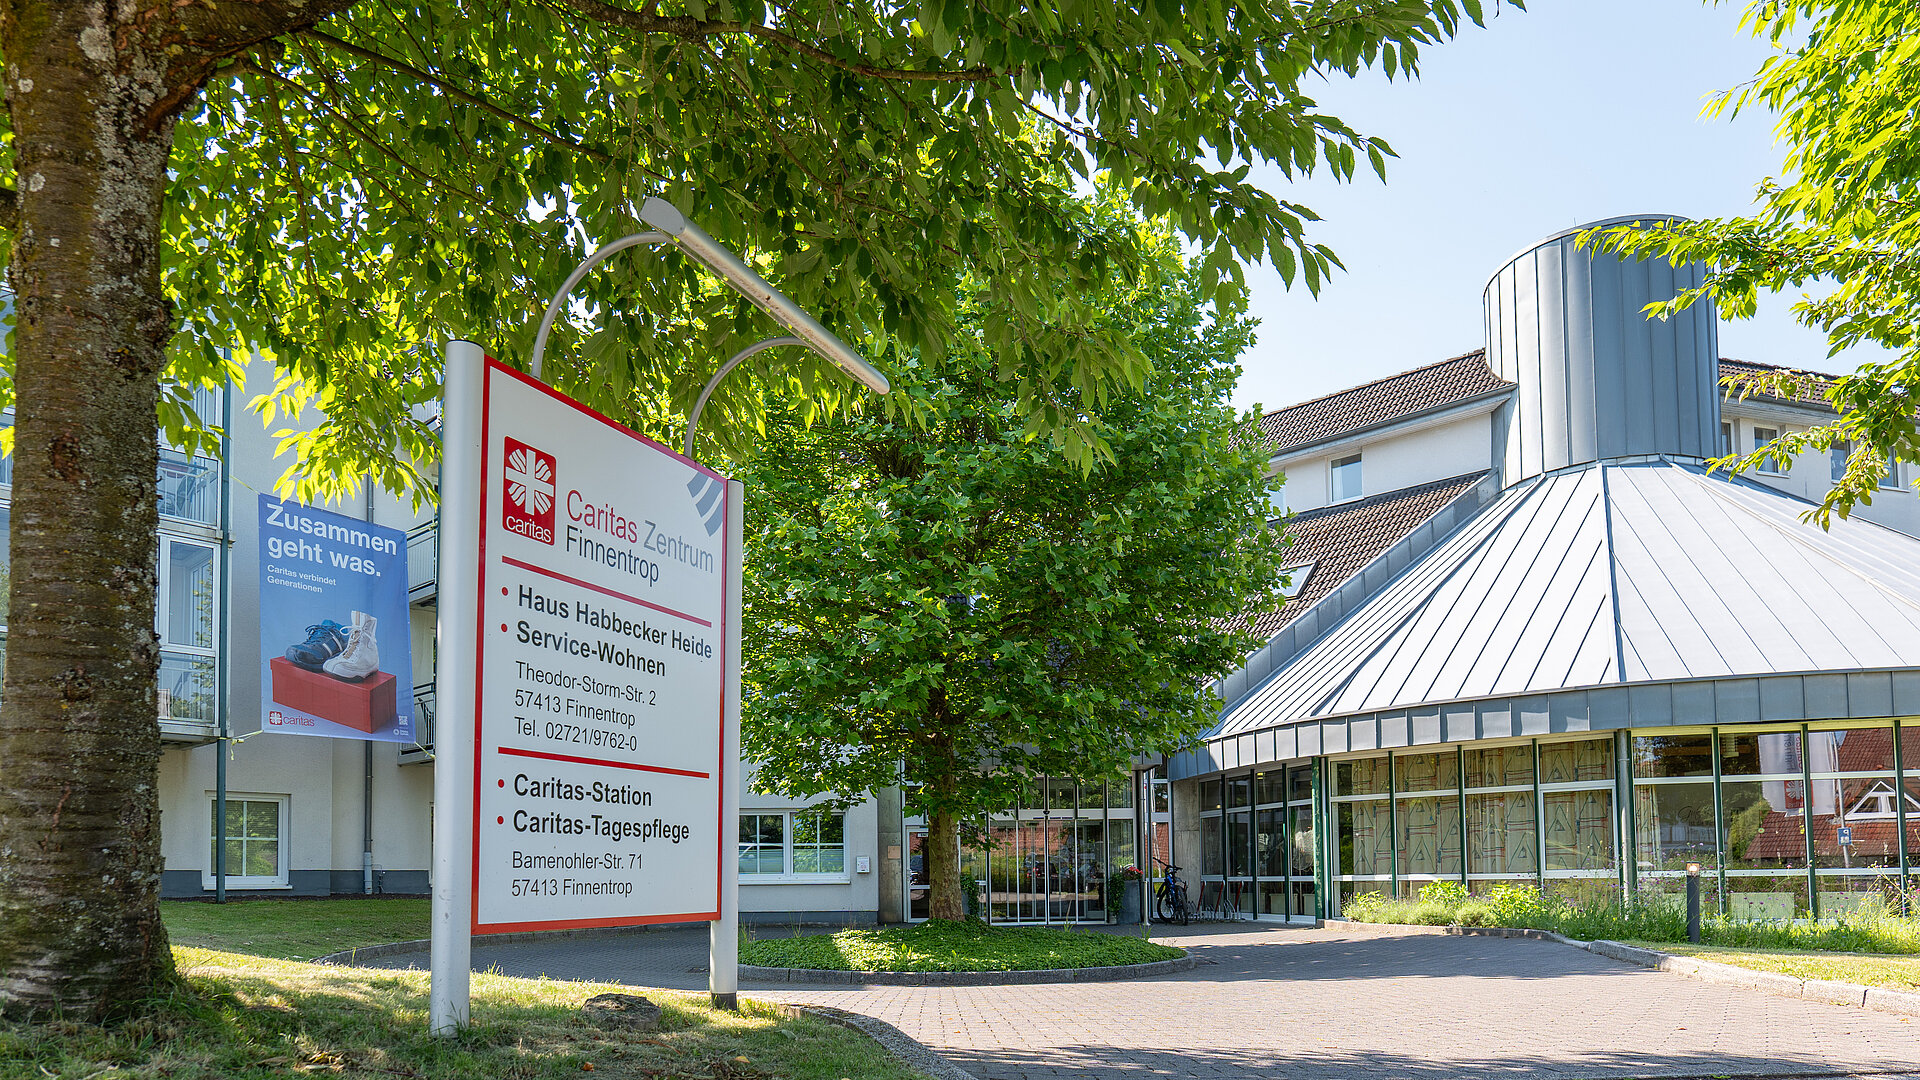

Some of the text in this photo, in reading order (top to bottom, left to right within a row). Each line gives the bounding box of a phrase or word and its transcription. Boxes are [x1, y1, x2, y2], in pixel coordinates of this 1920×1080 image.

[266, 503, 397, 556] Zusammen
[506, 515, 552, 543] caritas
[567, 489, 714, 574] Caritas Zentrum
[267, 536, 381, 577] geht was.
[566, 525, 659, 587] Finnentrop
[267, 564, 336, 586] Caritas verbindet
[267, 575, 323, 593] Generationen
[518, 584, 712, 659] Haus Habbecker Heide
[516, 620, 666, 677] Service-Wohnen
[515, 660, 656, 706] Theodor-Storm-Str. 2
[282, 716, 315, 727] caritas
[514, 689, 636, 730] 57413 Finnentrop
[514, 717, 637, 752] Tel. 02721/9762-0
[513, 773, 652, 807] Caritas-Station
[513, 809, 690, 844] Caritas-Tagespflege
[512, 851, 643, 870] Bamenohler-Str. 71
[511, 879, 633, 898] 57413 Finnentrop
